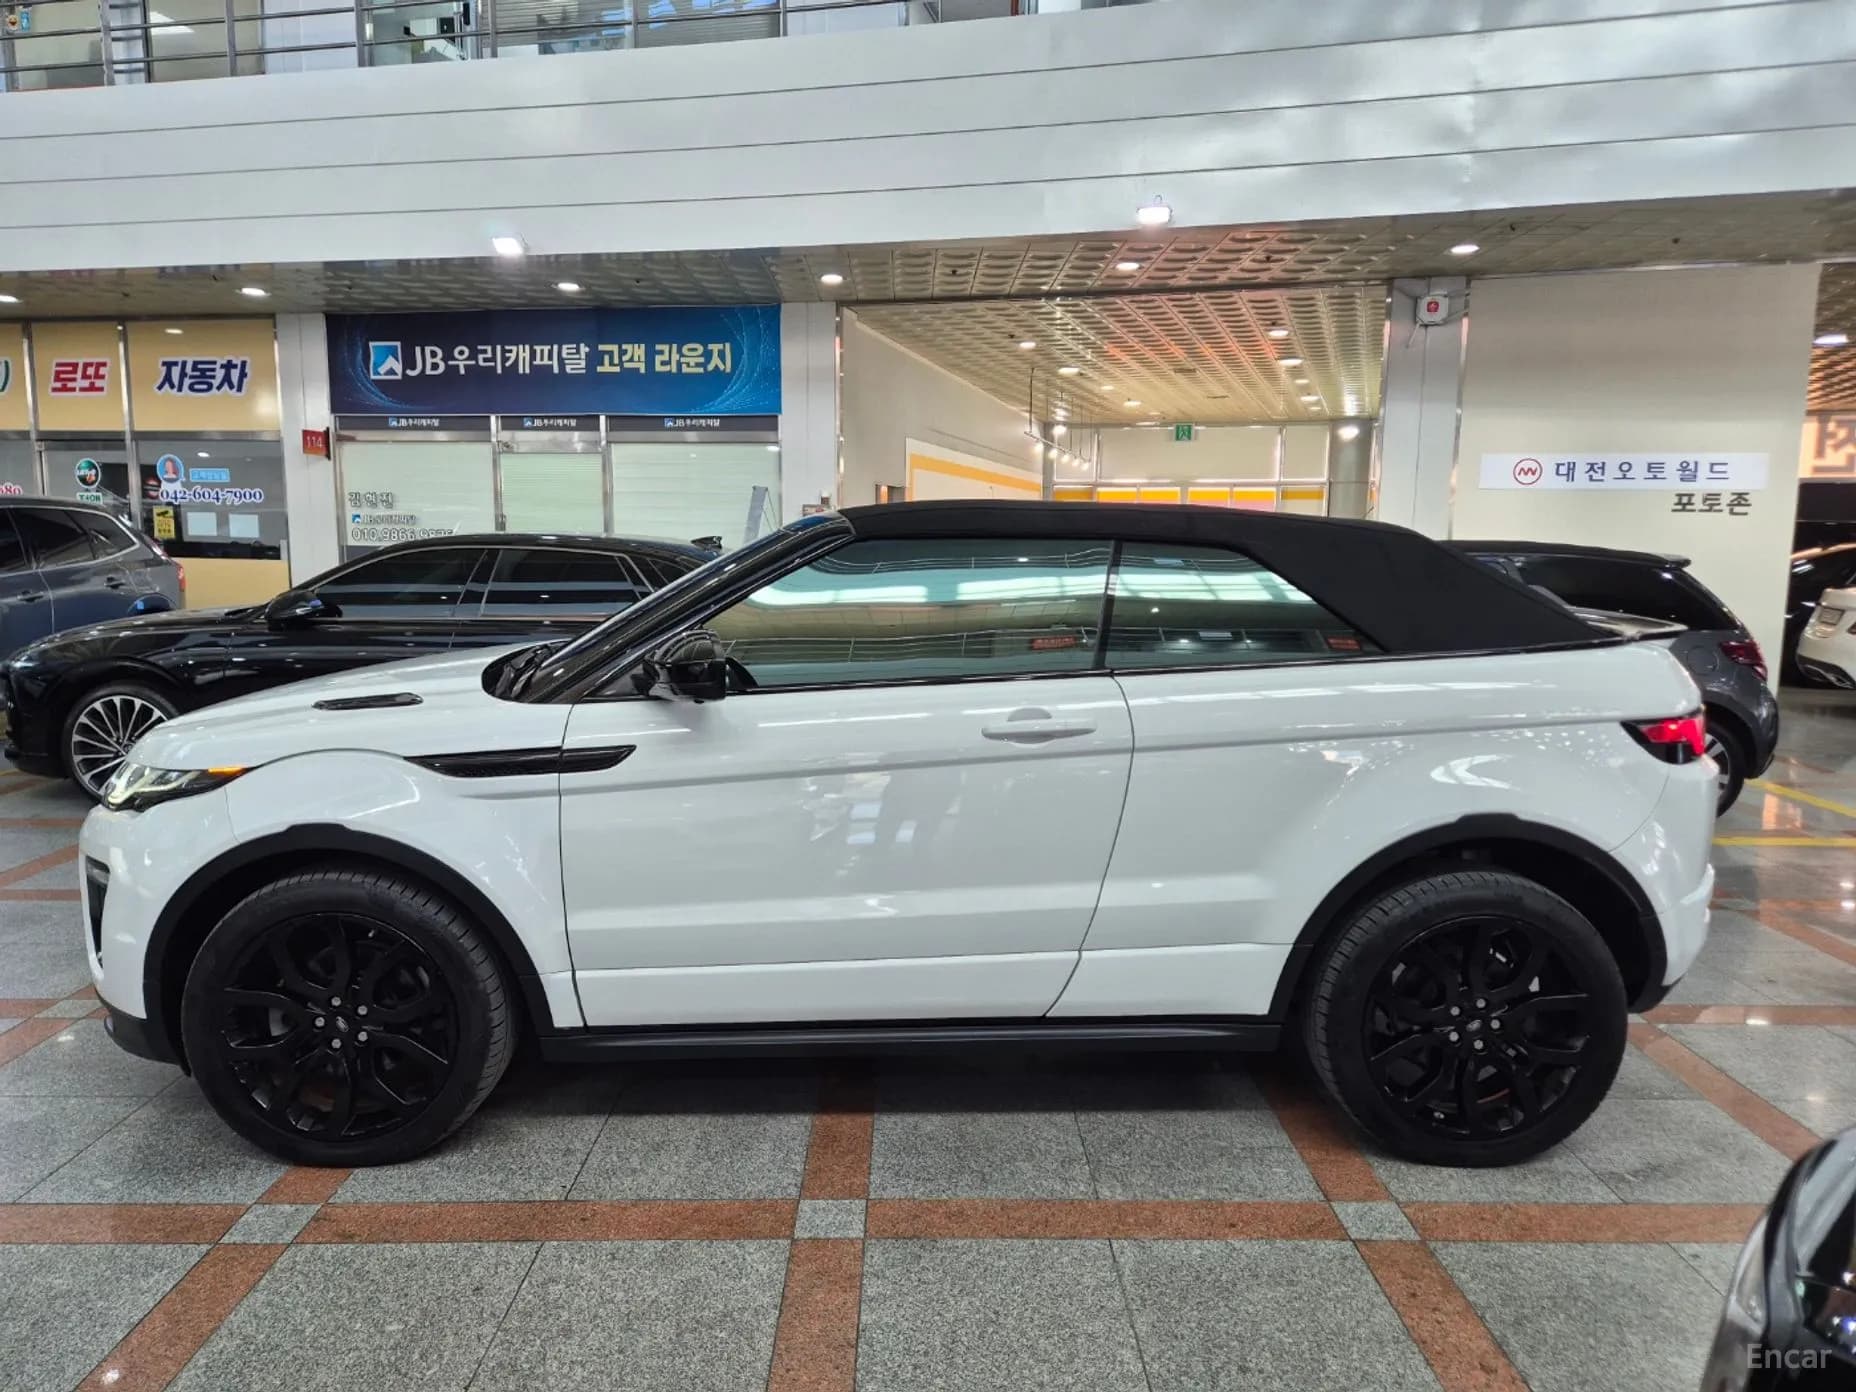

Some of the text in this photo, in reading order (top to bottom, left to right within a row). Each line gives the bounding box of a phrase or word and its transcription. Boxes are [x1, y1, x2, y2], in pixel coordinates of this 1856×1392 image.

[406, 342, 732, 377] JB우리캐피탈 고객 라운지
[51, 361, 108, 393] 로또
[156, 359, 249, 394] 자동차
[1554, 460, 1731, 483] 대전오토월드
[160, 486, 263, 504] 042-604-7900
[1671, 491, 1752, 516] 포토존
